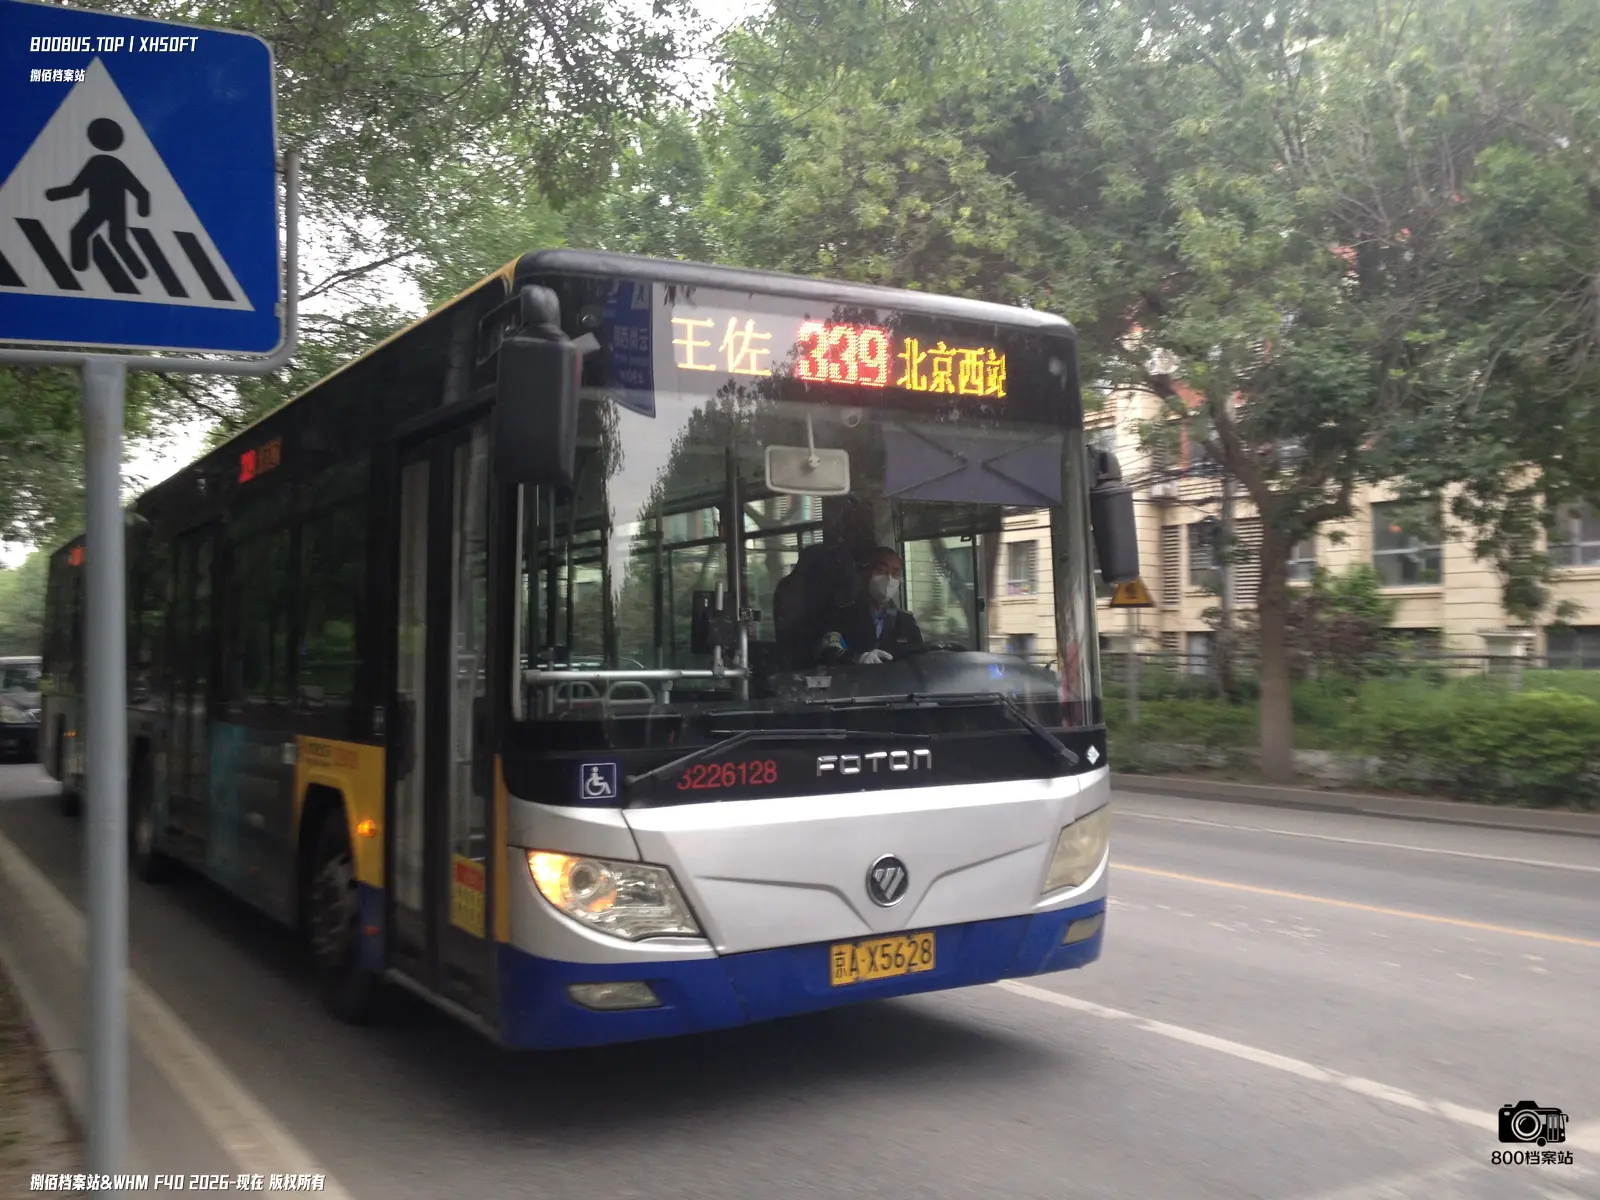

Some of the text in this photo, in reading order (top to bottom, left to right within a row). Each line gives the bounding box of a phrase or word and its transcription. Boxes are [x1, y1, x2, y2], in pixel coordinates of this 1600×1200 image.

[671, 316, 772, 376] 王佐
[798, 321, 890, 388] 339
[897, 337, 1007, 398] 北京西站
[677, 759, 778, 790] 3226128
[816, 750, 932, 777] FOTON
